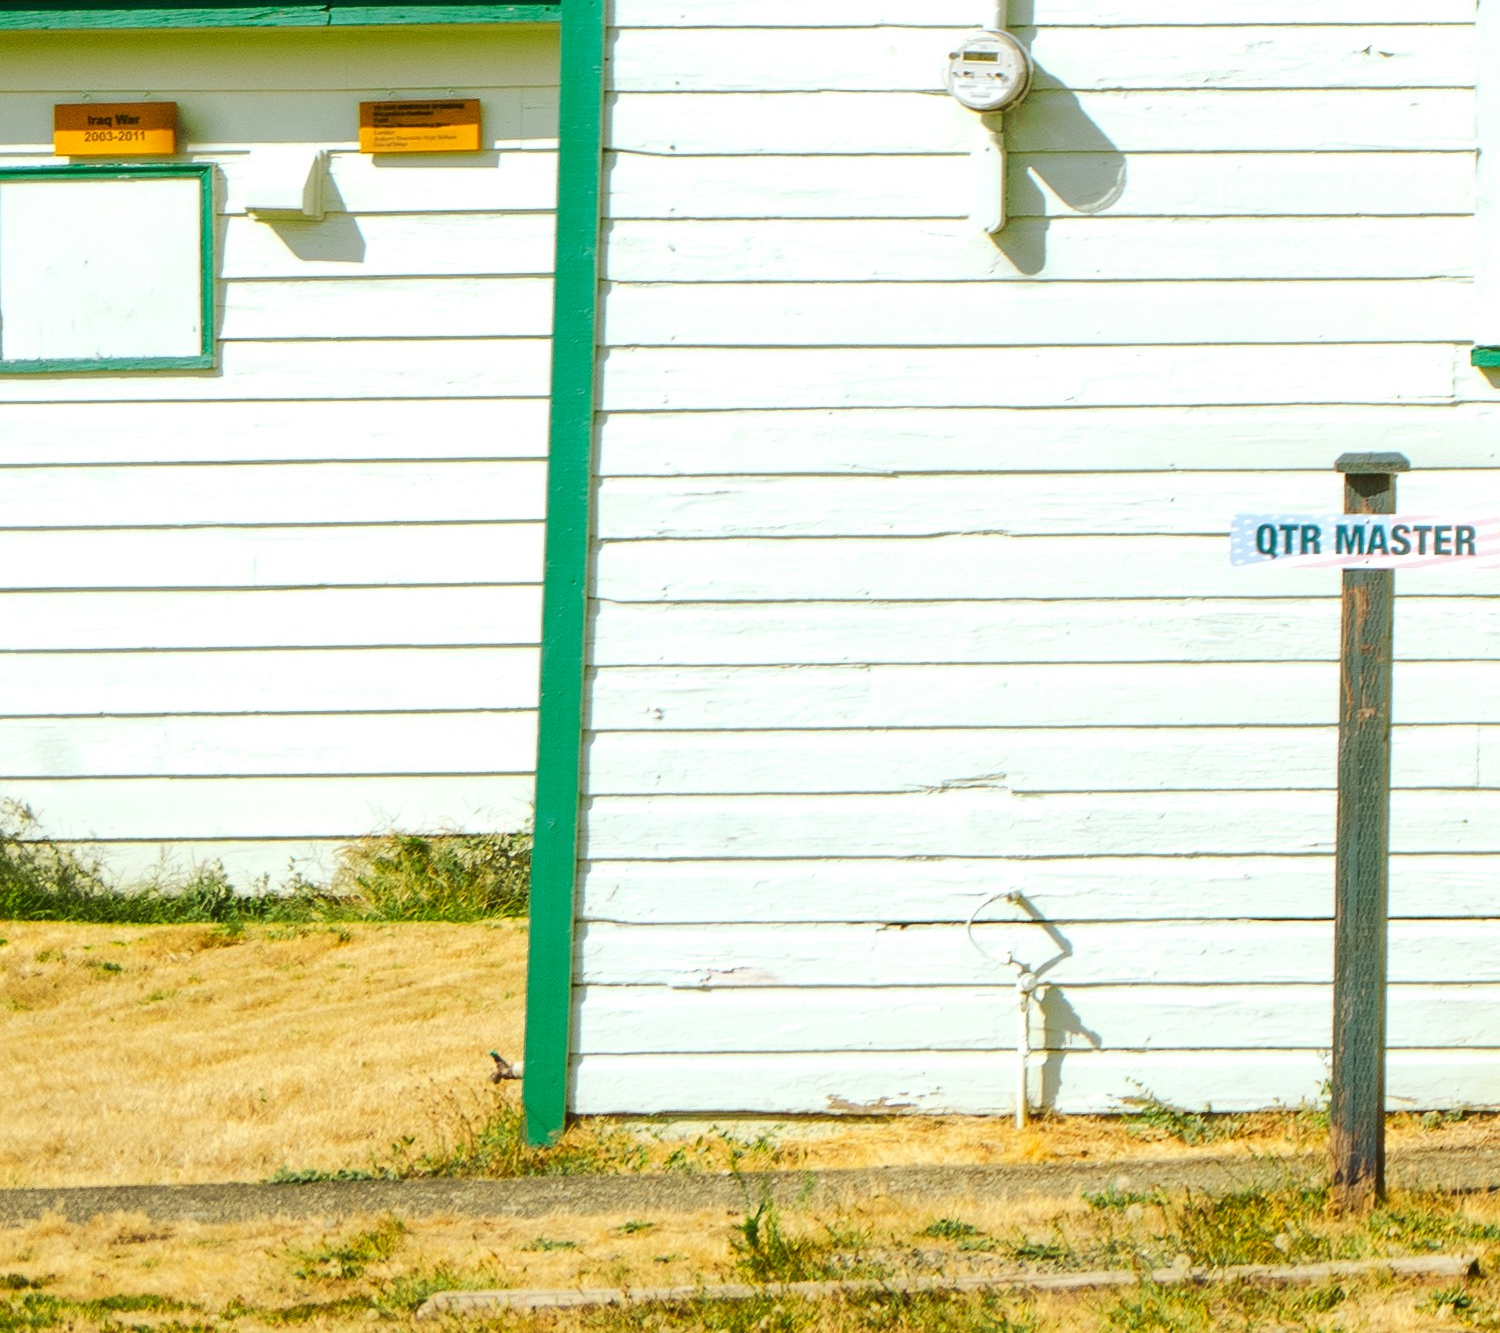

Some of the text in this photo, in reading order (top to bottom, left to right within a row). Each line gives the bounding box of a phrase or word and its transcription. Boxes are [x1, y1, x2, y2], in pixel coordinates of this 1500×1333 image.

[88, 115, 141, 127] Iraq War
[84, 131, 145, 142] 2003-2011
[1256, 523, 1477, 558] QTR MASTER
